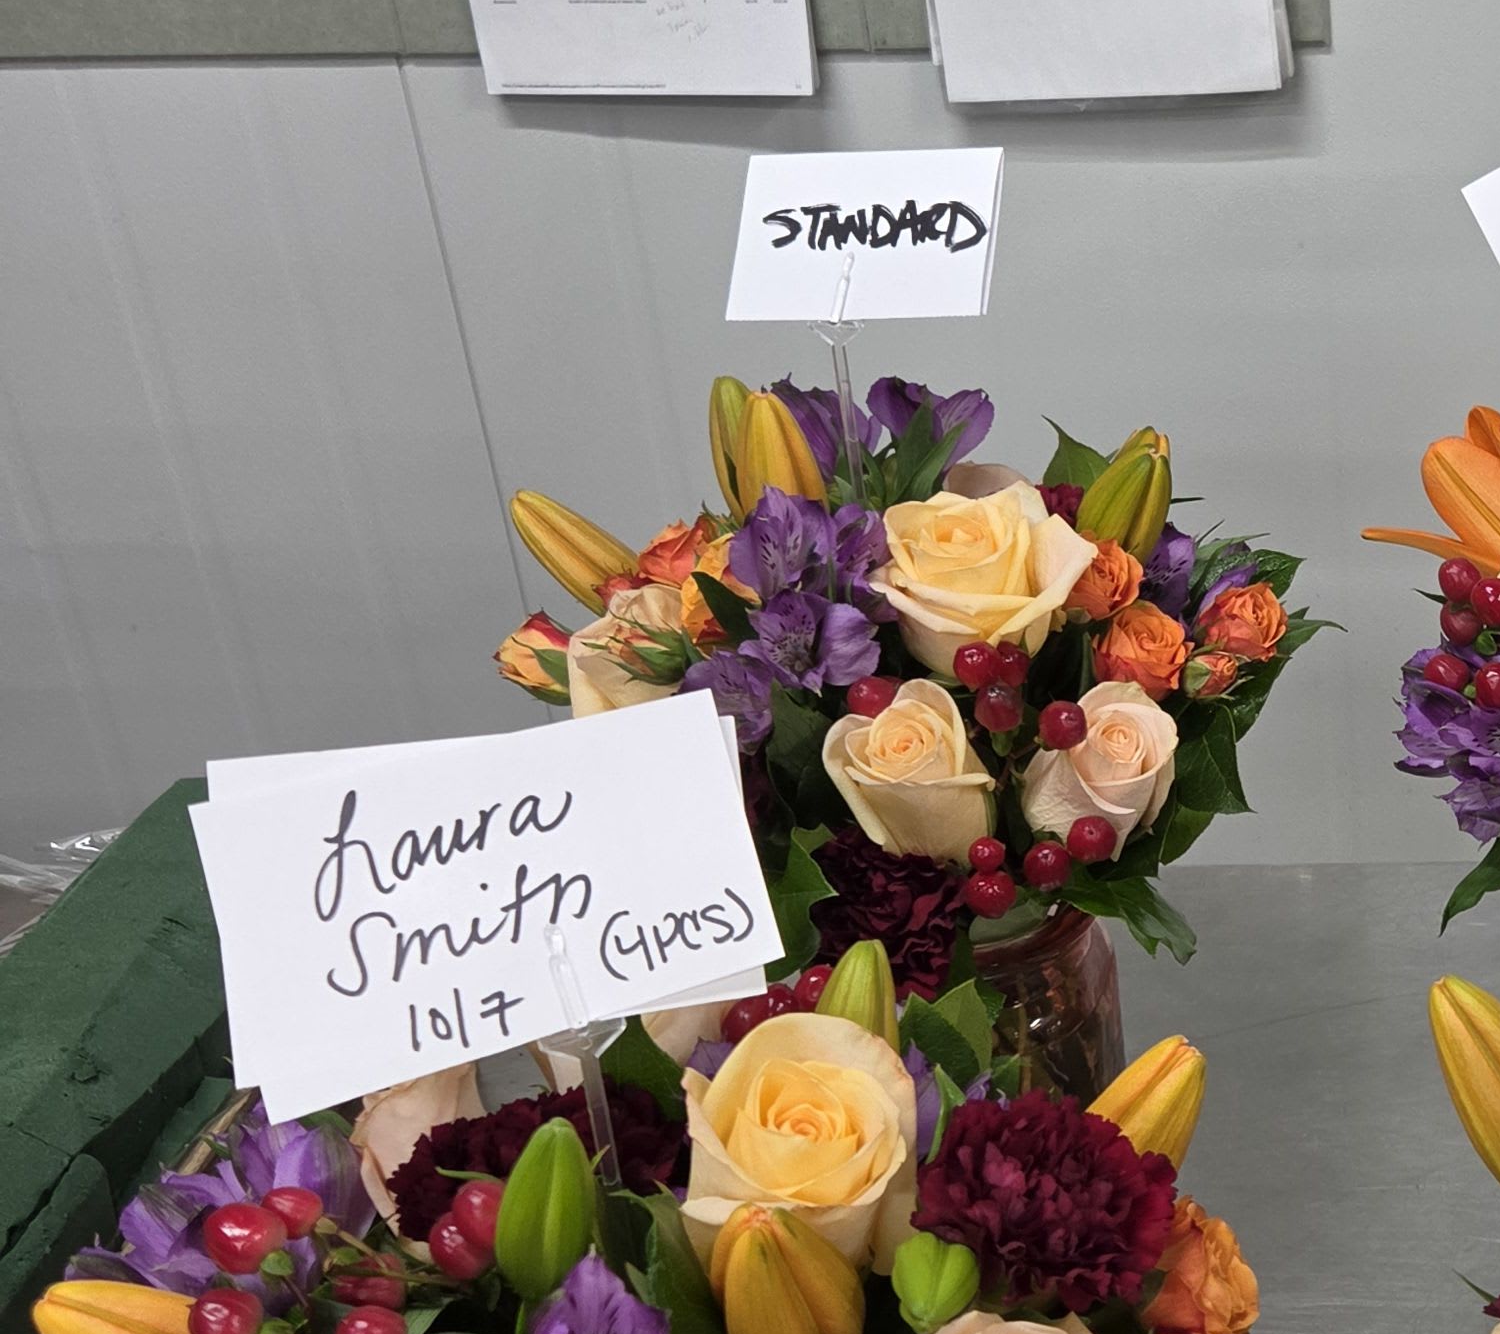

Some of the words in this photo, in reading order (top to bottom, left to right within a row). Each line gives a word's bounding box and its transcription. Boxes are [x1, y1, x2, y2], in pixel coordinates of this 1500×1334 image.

[762, 201, 990, 254] STANDARD
[315, 789, 574, 922] Laura
[327, 864, 593, 998] Smith
[409, 986, 524, 1052] 10/7
